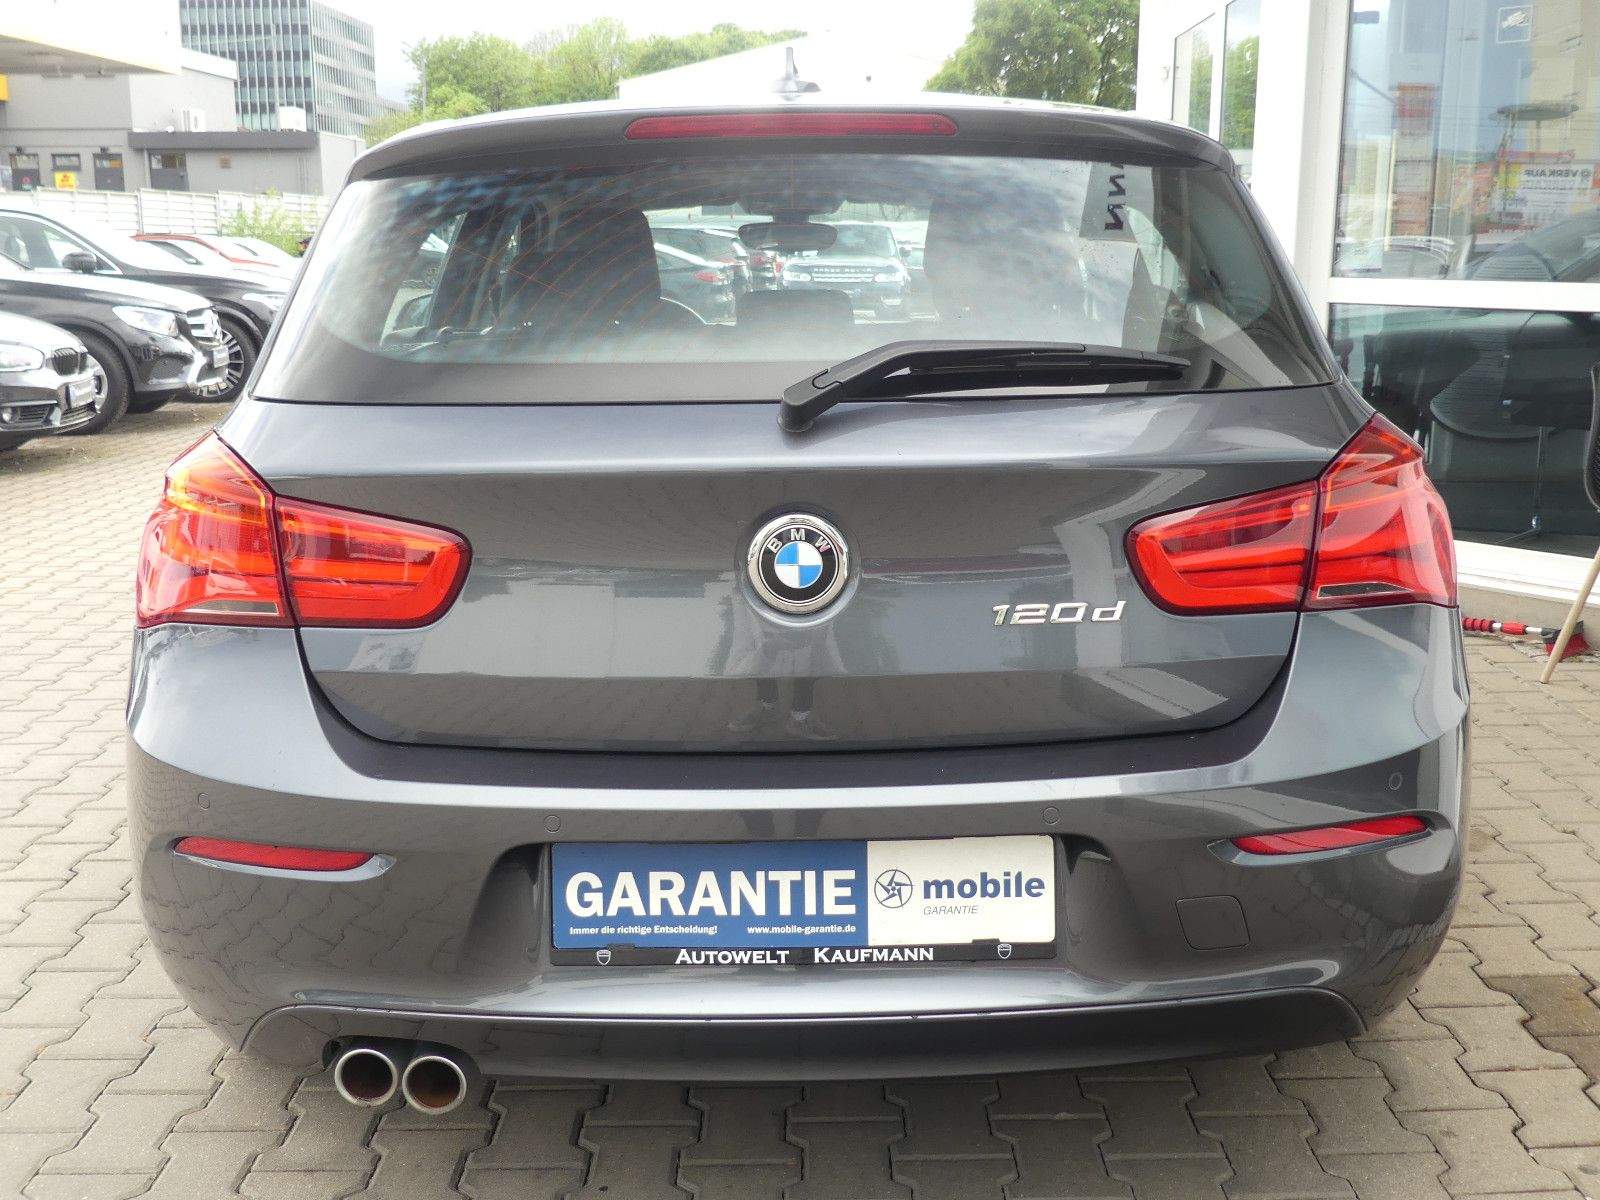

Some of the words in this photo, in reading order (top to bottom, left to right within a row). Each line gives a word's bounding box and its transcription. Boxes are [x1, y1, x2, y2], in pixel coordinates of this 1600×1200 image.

[767, 528, 831, 554] BMW
[992, 600, 1127, 626] 120d
[565, 869, 857, 917] GARANTIE
[923, 871, 1046, 899] mobile
[923, 904, 979, 916] GARANTIE
[569, 926, 598, 935] Immer
[601, 926, 615, 935] die
[617, 925, 652, 935] richtige
[654, 924, 718, 936] Entscheidung!
[747, 923, 857, 935] www.mobile-garantie.de
[675, 948, 790, 964] AUTOWELT
[813, 947, 934, 963] KAUFMANN
